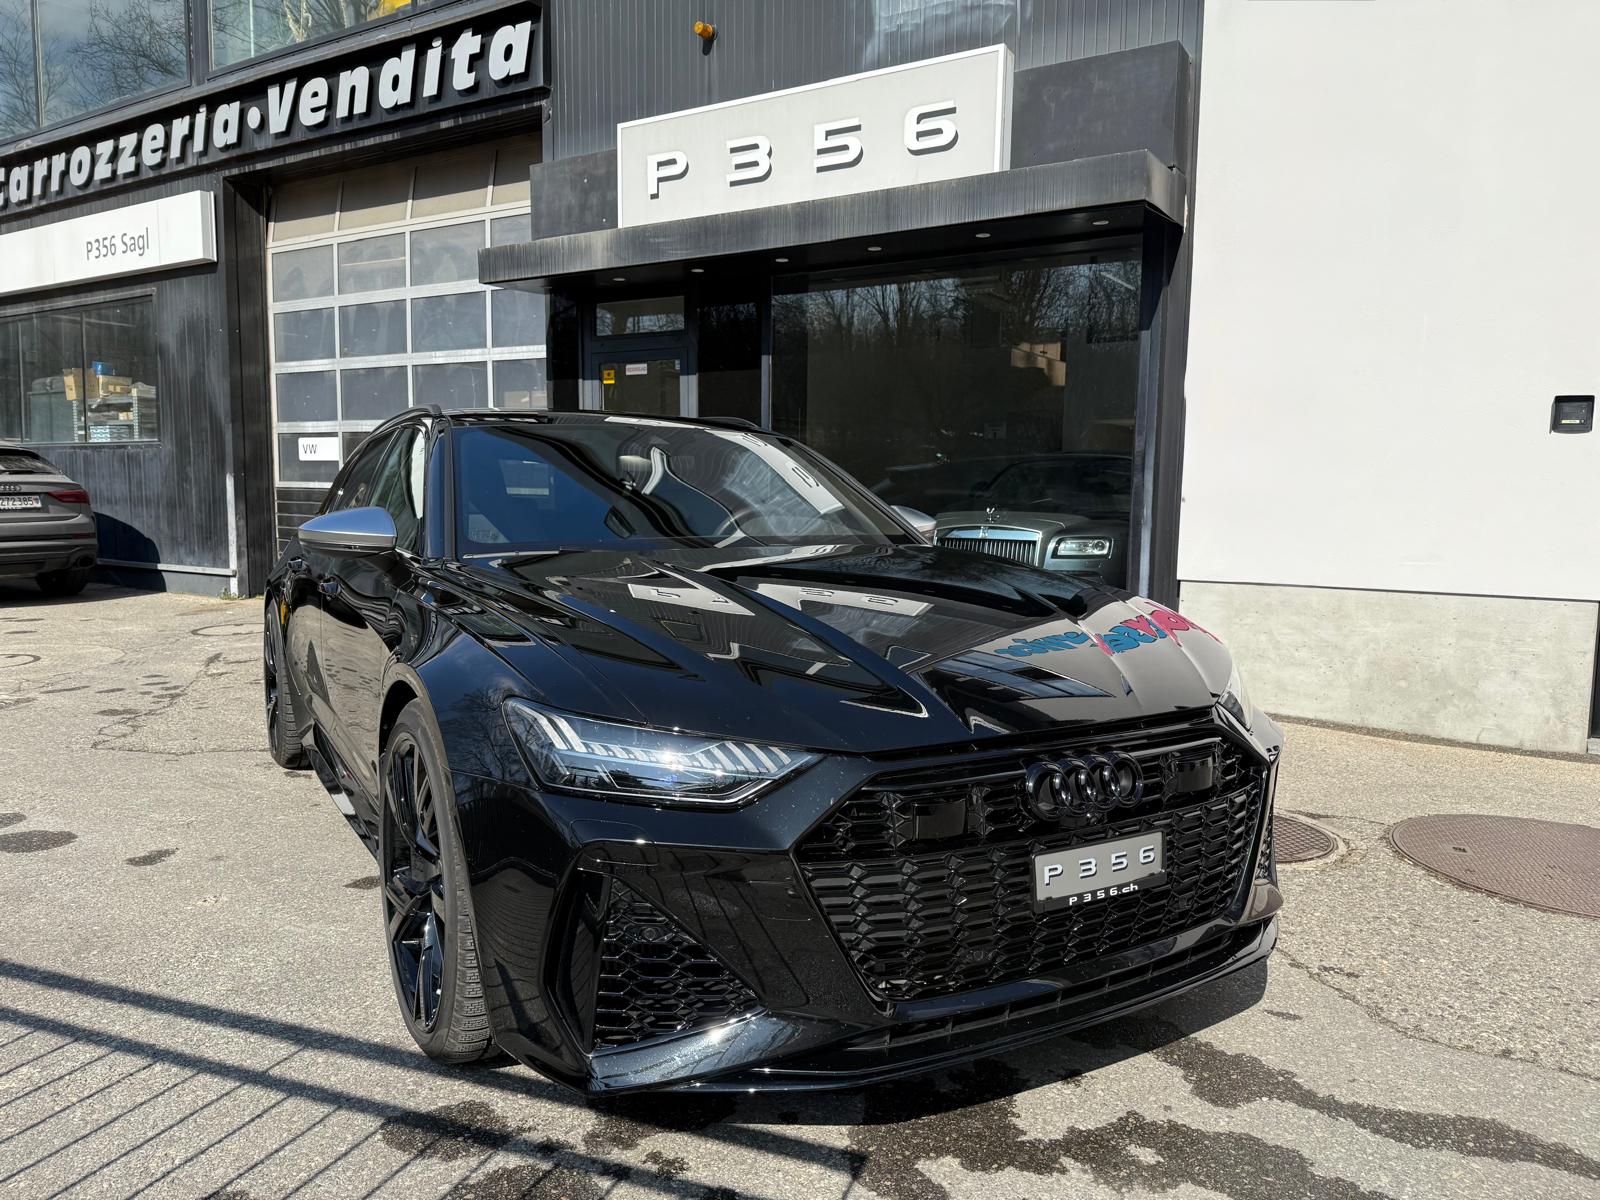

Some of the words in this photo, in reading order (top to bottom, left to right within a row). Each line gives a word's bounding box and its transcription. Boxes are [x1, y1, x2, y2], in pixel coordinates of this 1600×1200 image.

[267, 20, 532, 134] Vendita
[86, 235, 117, 261] P356
[121, 226, 149, 257] Sagl
[302, 444, 317, 454] VW
